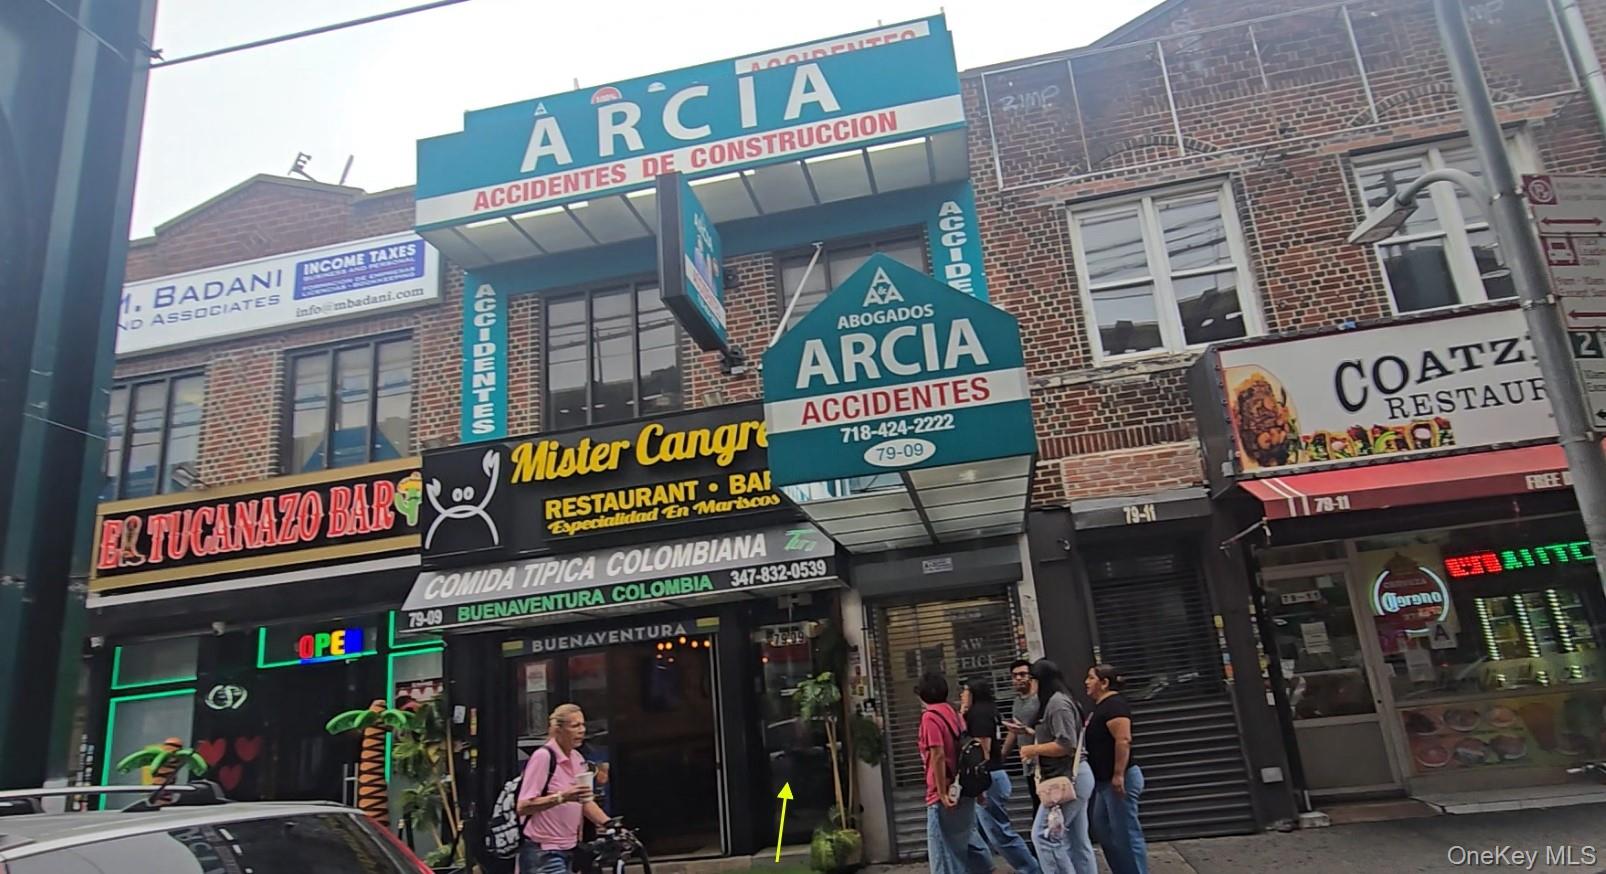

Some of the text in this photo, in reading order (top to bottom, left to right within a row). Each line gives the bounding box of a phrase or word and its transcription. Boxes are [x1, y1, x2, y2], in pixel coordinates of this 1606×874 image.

[473, 110, 898, 211] ACCIDENTES DE CONSTRUCCION
[304, 244, 416, 275] INCOME TAXES
[939, 201, 976, 297] ACCIDE
[154, 269, 282, 308] BADANI
[152, 294, 280, 328] ASSOCIATES
[837, 304, 934, 330] ABOGADOS
[472, 283, 497, 434] ACCIDENTES
[796, 318, 990, 389] ARCIA
[1577, 332, 1597, 355] 2
[1335, 335, 1539, 413] COATZ
[801, 376, 990, 426] ACCIDENTES
[840, 414, 955, 443] 718-424-2222
[510, 438, 630, 484] Mister
[876, 443, 924, 461] 79-09
[545, 480, 698, 520] RESTAURANT
[547, 492, 780, 536] Especialidad En Mariscos
[1123, 504, 1156, 524] 79-11
[1315, 496, 1350, 513] 79-11
[147, 490, 322, 563] TUCANAZO
[327, 480, 394, 537] BAR
[424, 565, 515, 600] COMIDA
[522, 557, 595, 590] TIPICA
[606, 534, 767, 577] COLOMBIANA
[730, 560, 827, 587] 347-832-0539
[408, 574, 715, 627] 79-09 BUENAVENTURA COLOMBIA
[299, 627, 363, 659] OPEN
[532, 623, 687, 653] BUENAVENTURA
